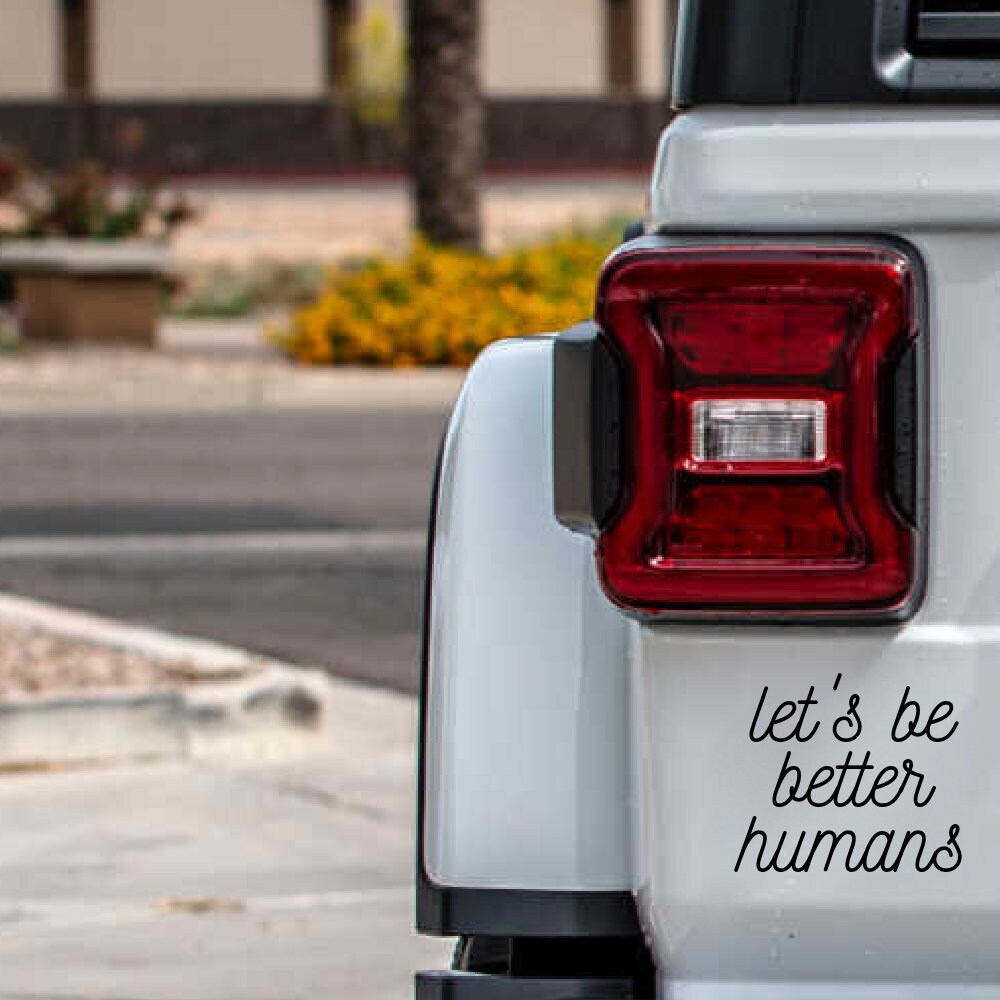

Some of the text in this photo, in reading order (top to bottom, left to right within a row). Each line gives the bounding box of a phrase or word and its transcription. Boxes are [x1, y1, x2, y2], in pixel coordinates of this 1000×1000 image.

[749, 673, 959, 742] let's be
[771, 750, 937, 808] better
[733, 815, 963, 873] humans
